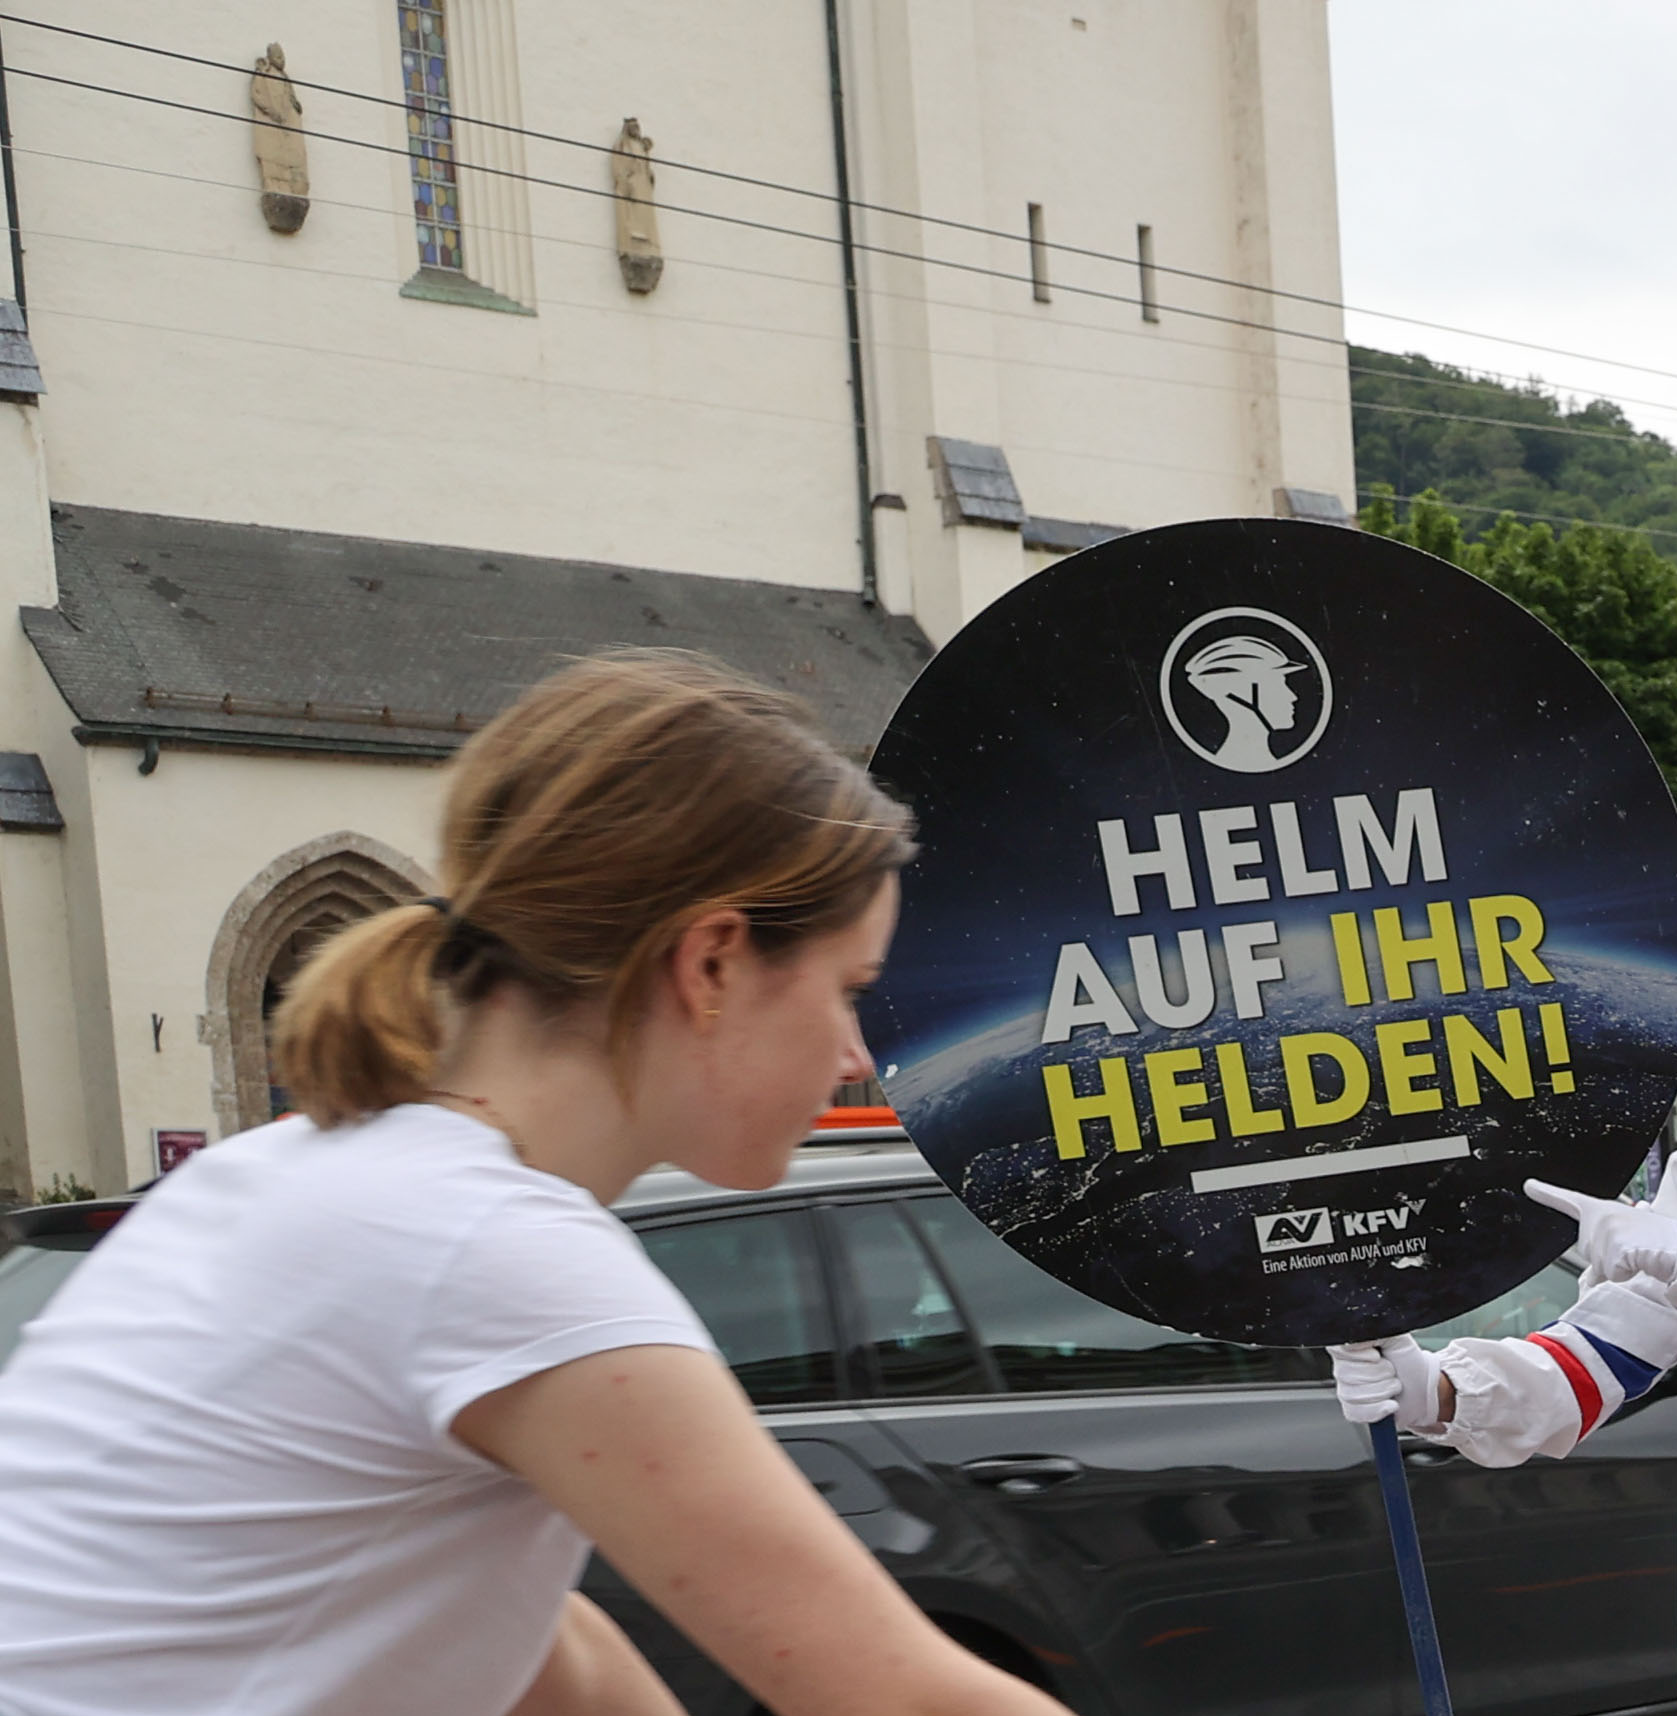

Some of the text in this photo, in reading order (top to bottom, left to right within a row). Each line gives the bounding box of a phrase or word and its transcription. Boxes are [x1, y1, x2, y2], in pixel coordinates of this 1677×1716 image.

[1097, 788, 1448, 916] HELM
[1041, 895, 1554, 1044] AUF IHR
[1043, 1003, 1575, 1160] HELDEN!
[1262, 1236, 1428, 1274] Eine Aktion von AUVA und KFV
[1343, 1206, 1410, 1237] KFV
